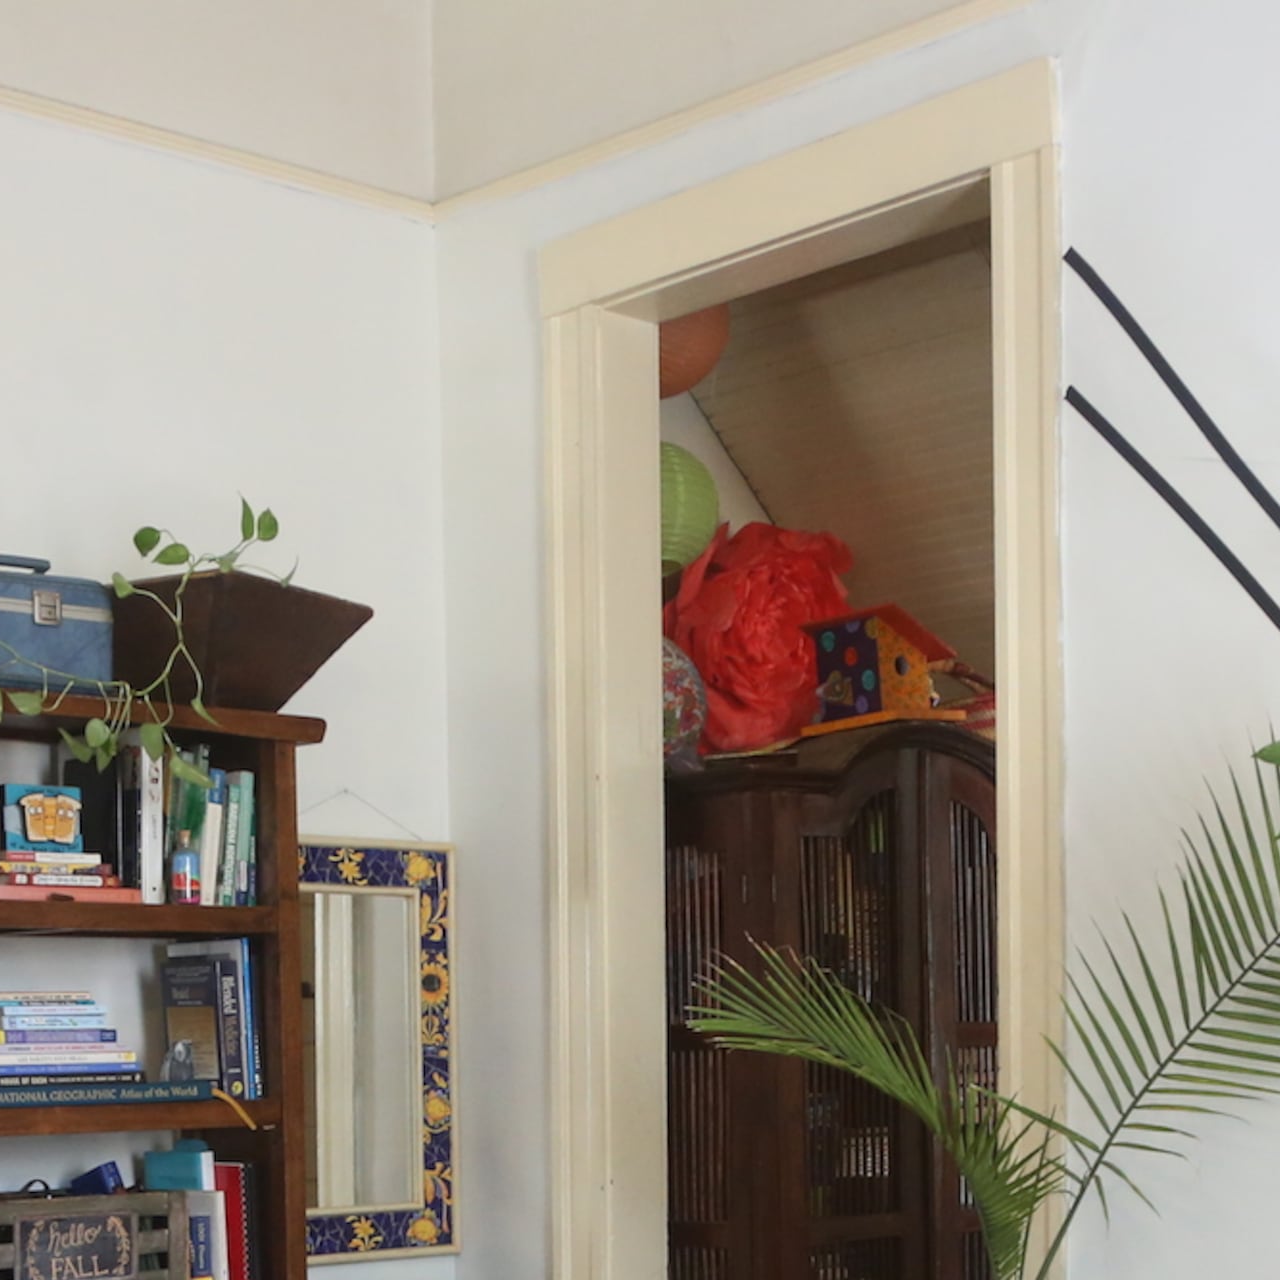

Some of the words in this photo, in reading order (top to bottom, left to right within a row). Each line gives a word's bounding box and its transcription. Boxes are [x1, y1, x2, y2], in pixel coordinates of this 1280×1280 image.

[222, 975, 238, 1015] Blended
[50, 1089, 117, 1102] GEOGRAPHIC
[120, 1088, 139, 1100] Atlas
[140, 1087, 150, 1099] of
[151, 1087, 168, 1098] the
[169, 1085, 199, 1097] World
[47, 1221, 102, 1257] hello
[51, 1255, 109, 1280] FALL
